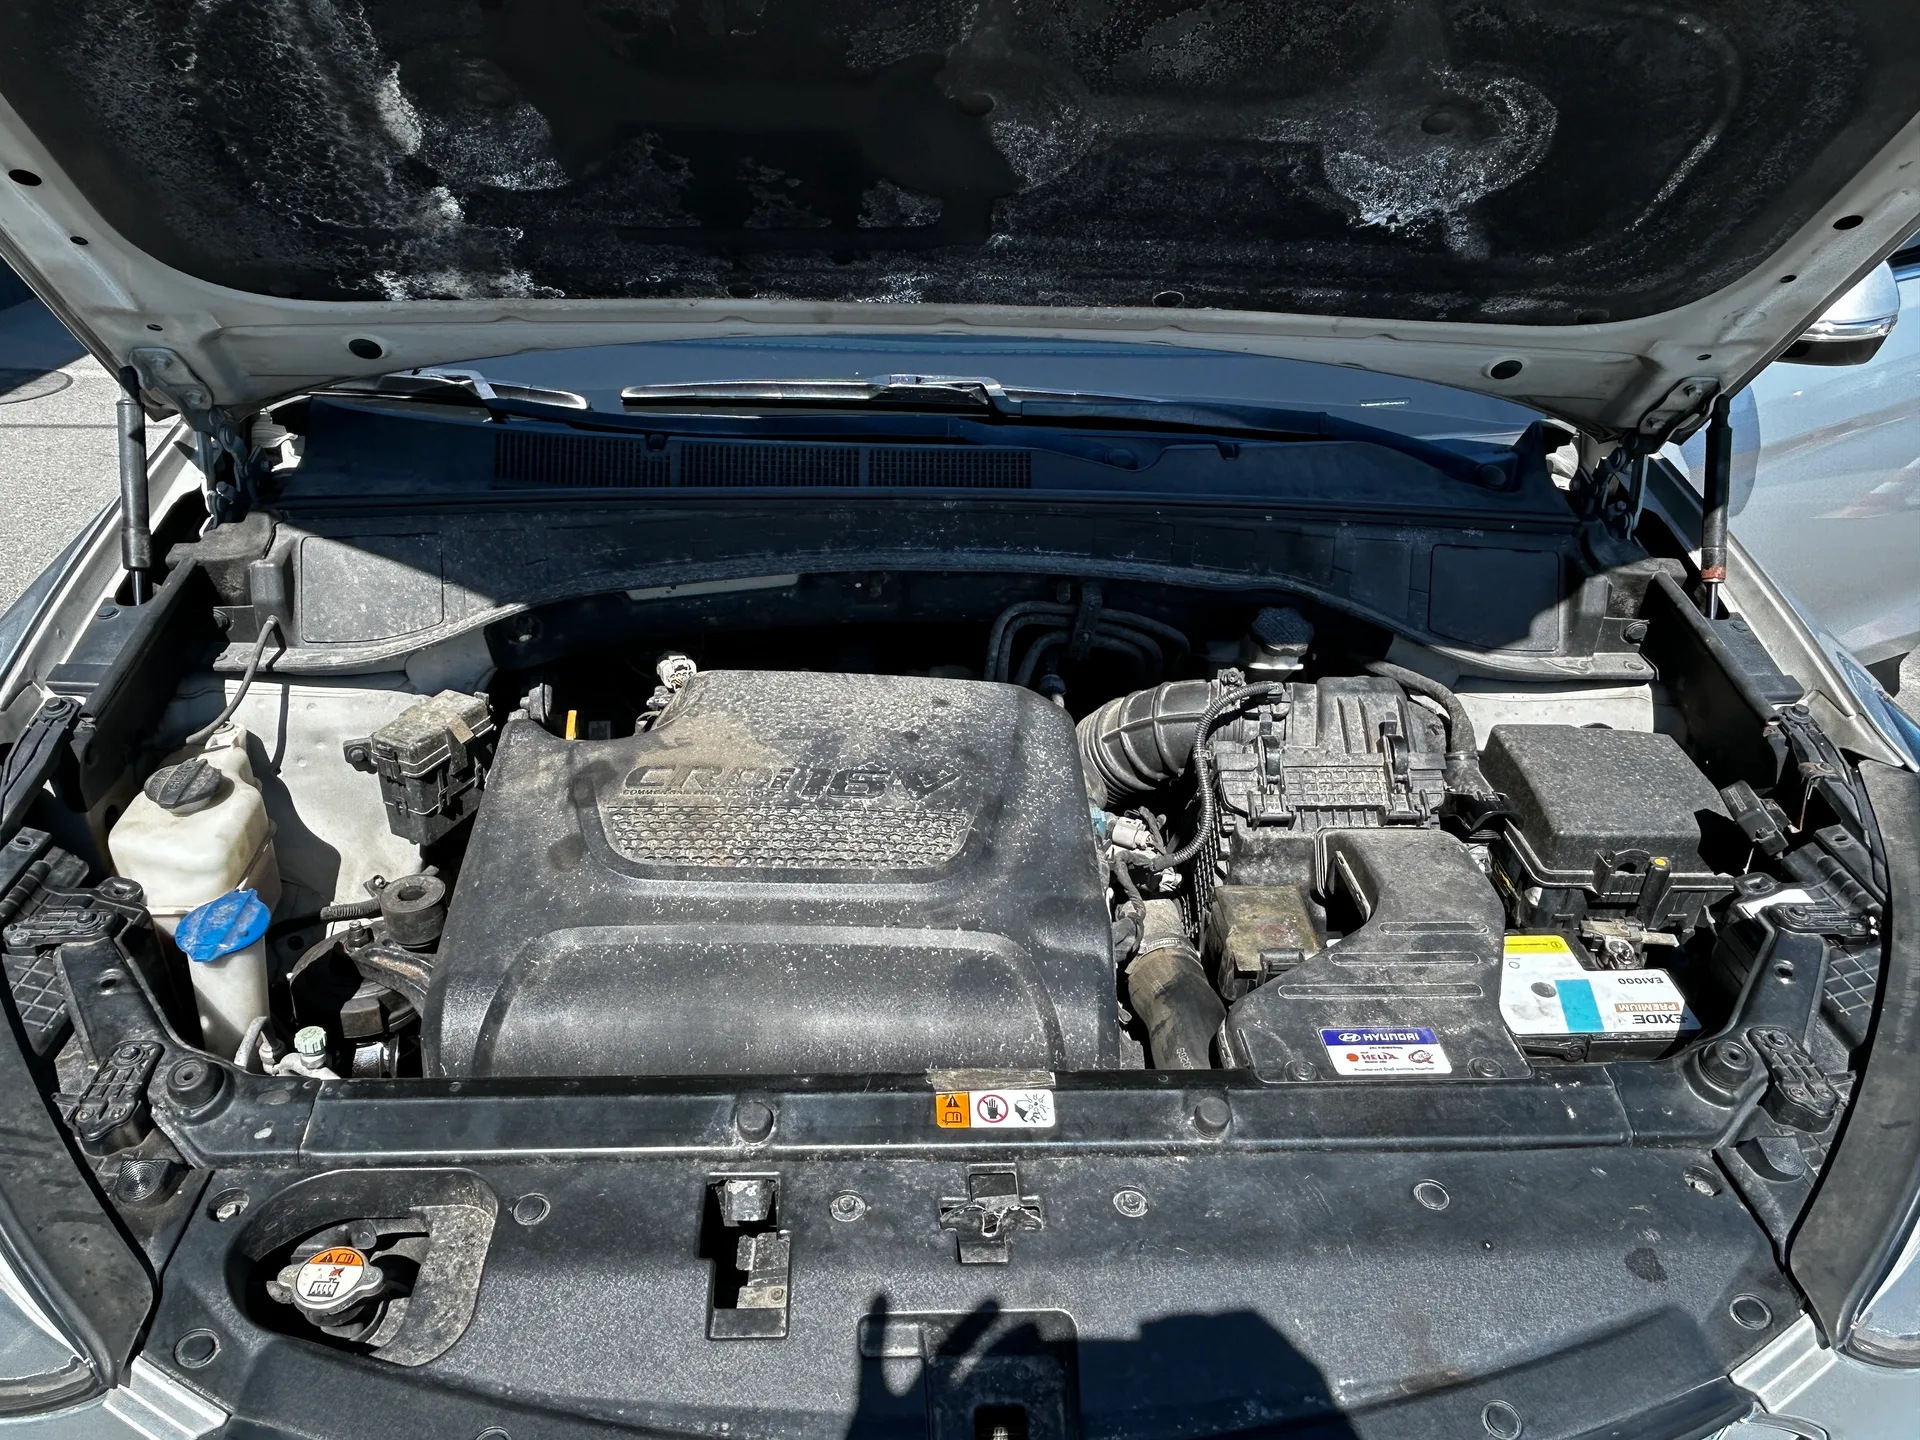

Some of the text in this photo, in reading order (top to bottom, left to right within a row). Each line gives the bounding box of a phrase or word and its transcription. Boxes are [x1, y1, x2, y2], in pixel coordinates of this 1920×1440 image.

[1618, 976, 1664, 985] EA1000
[1618, 1003, 1678, 1012] PREMIUM
[1632, 1014, 1688, 1025] EXIDE
[1362, 1032, 1420, 1041] HYUNDAI
[1361, 1051, 1400, 1061] HELIX
